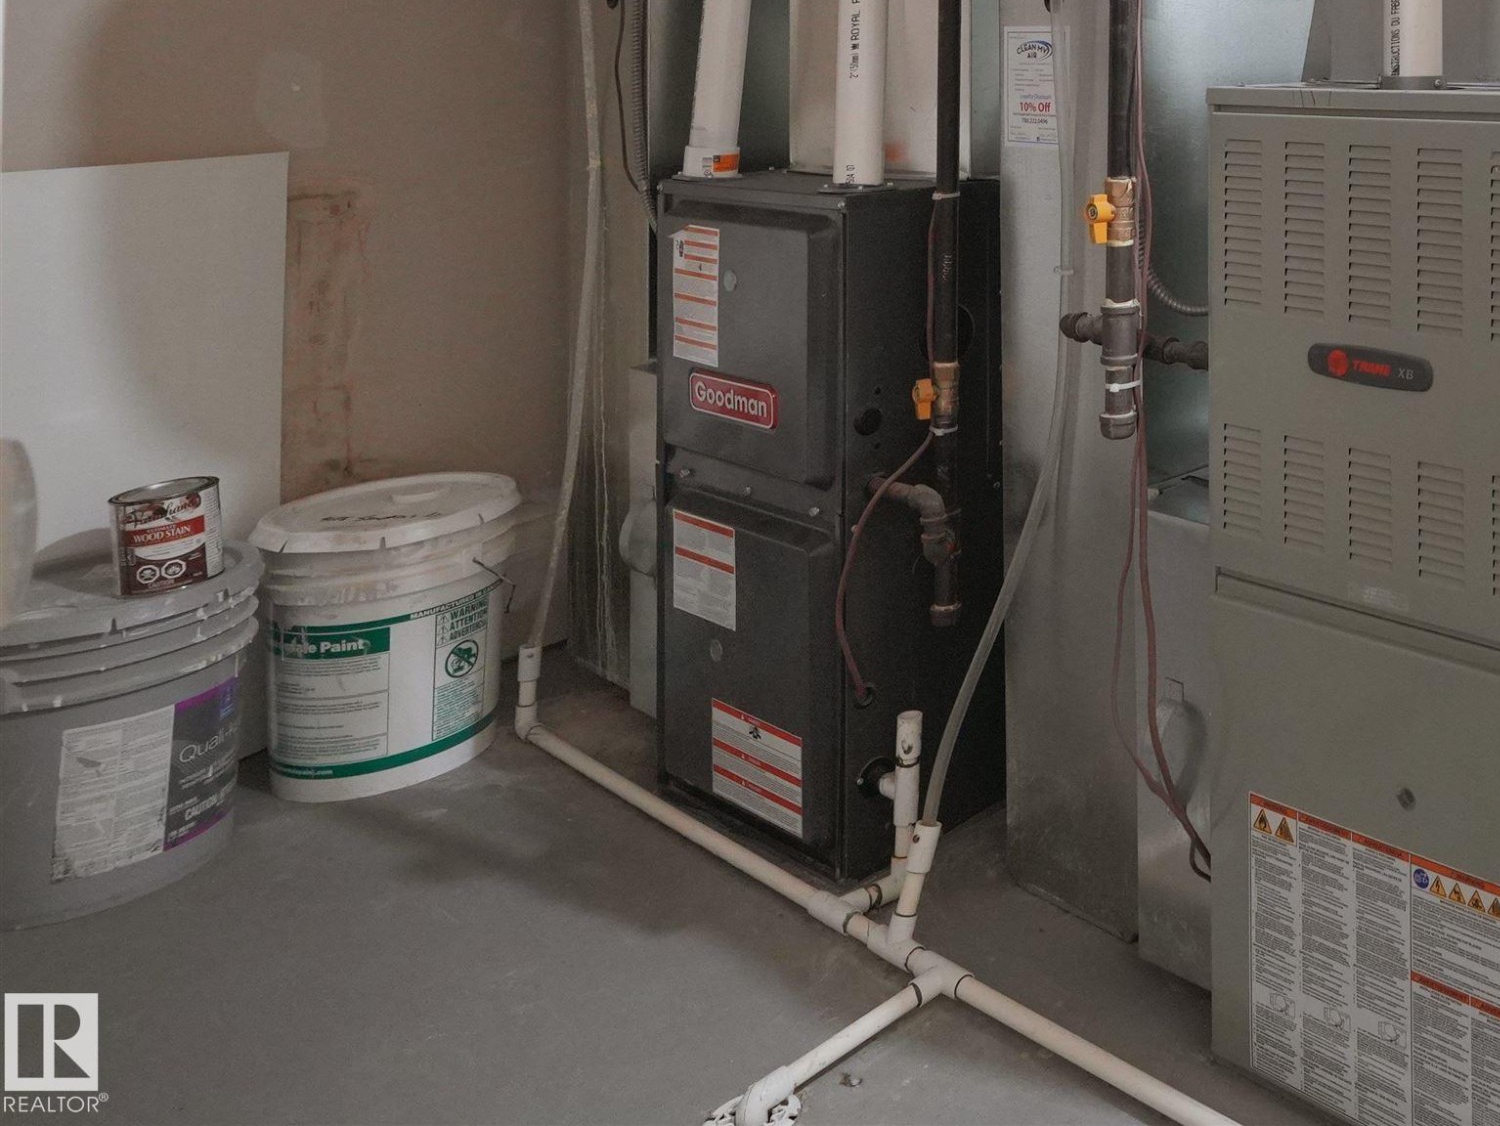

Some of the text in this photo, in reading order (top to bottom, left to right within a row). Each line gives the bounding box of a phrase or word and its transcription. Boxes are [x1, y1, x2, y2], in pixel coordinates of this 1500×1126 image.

[850, 10, 861, 41] ROYAL
[1016, 44, 1037, 55] CLEAN
[1019, 102, 1051, 112] 10% Off
[1352, 359, 1392, 377] TRANE
[694, 381, 767, 418] Goodman
[133, 525, 191, 543] WOOD STAIN
[410, 594, 474, 619] MANUFACTURED
[450, 597, 487, 620] WARNING
[450, 607, 488, 630] ATTENTION
[320, 638, 365, 653] Paint
[185, 793, 218, 821] CAUTION
